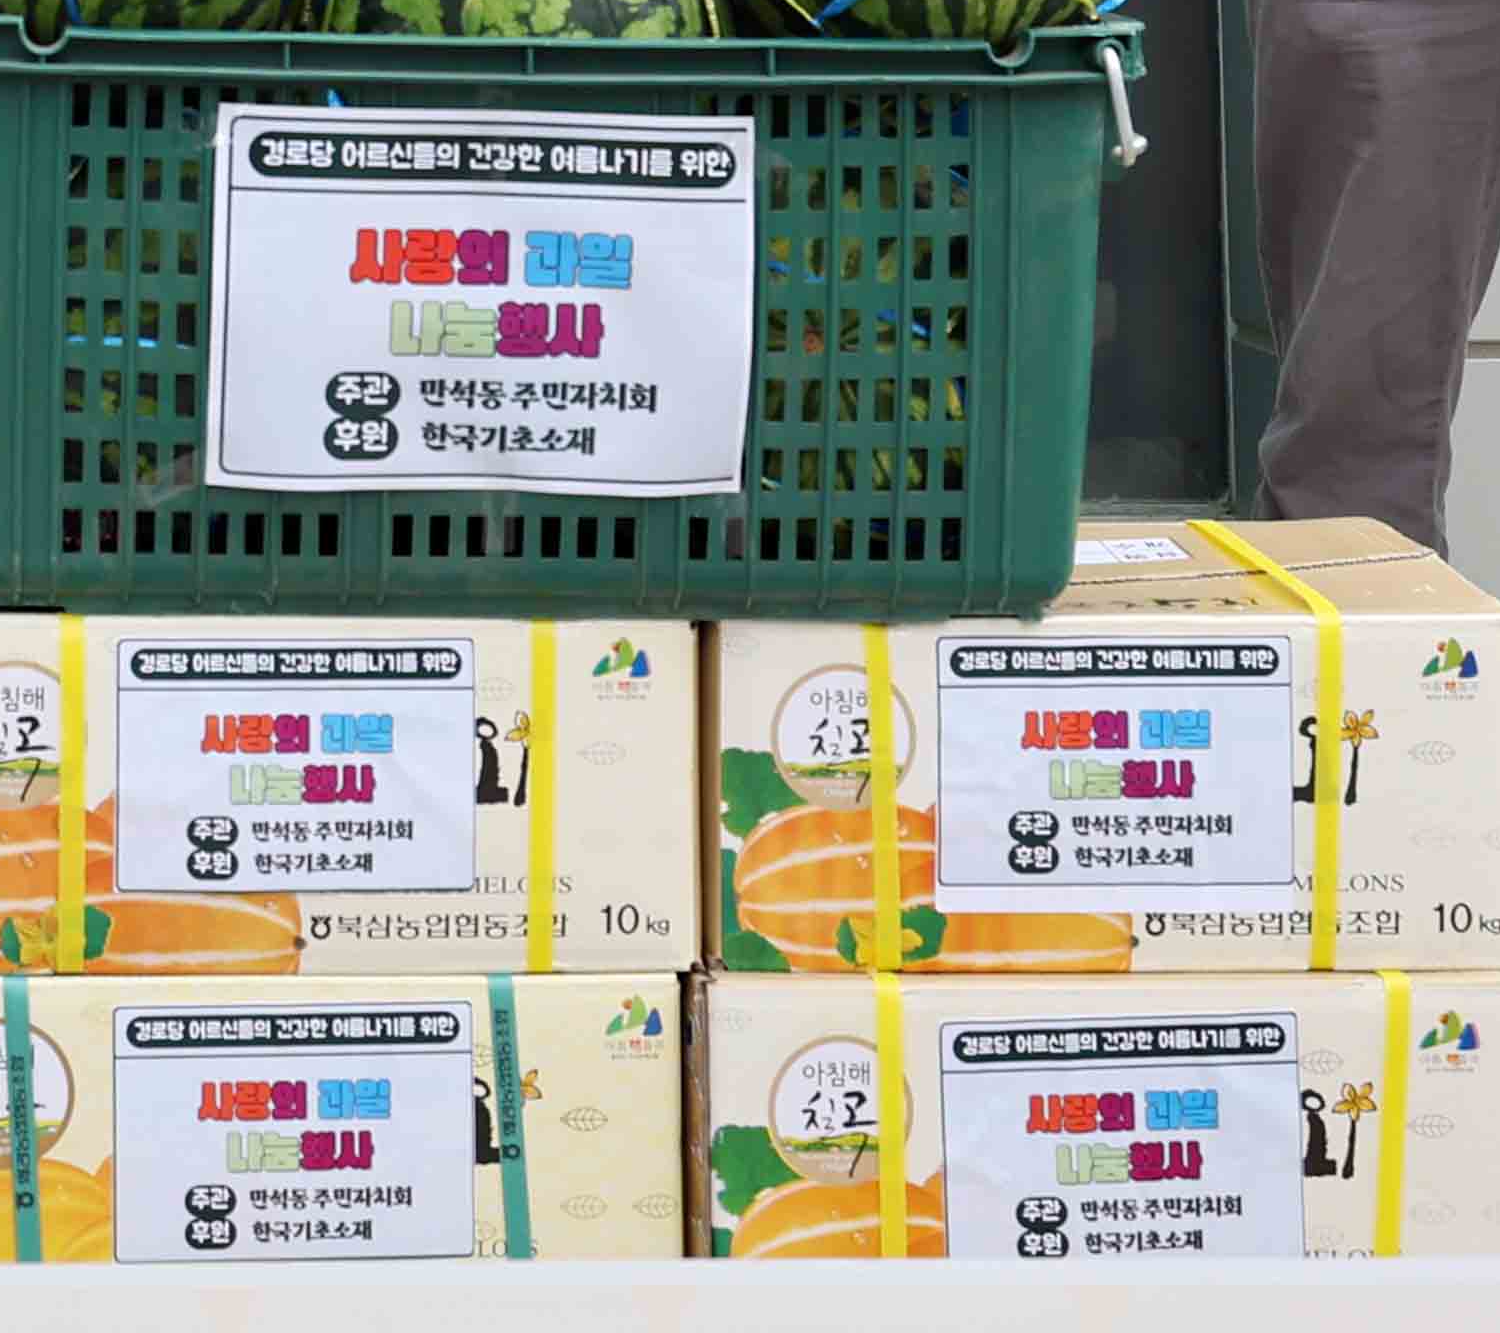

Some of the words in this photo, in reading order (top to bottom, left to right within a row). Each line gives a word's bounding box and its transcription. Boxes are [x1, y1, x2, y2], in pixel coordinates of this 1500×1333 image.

[260, 139, 335, 169] 경로당
[341, 142, 461, 172] 어르신들의
[468, 143, 544, 174] 건강한
[552, 147, 673, 176] 여름나기를
[680, 149, 731, 177] 위한
[350, 228, 509, 285] 사랑의
[524, 231, 633, 290] 과일
[390, 300, 603, 358] 나눔행사
[335, 376, 392, 407] 주관
[420, 379, 507, 410] 만석동
[512, 382, 658, 412] 주민자치회
[333, 419, 389, 452] 후원
[422, 423, 596, 455] 한국기초소재
[201, 714, 310, 754] 사랑의
[321, 714, 394, 754] 과일
[1021, 710, 1128, 749] 사랑의
[1139, 710, 1211, 749] 과일
[230, 764, 376, 805] 나눔행사
[1050, 759, 1194, 799] 나눔행사
[193, 820, 232, 840] 주관
[252, 821, 308, 842] 만석동
[315, 820, 413, 841] 주민자치회
[1014, 815, 1052, 834] 주관
[1072, 816, 1128, 836] 만석동
[1134, 815, 1232, 835] 주민자치회
[193, 853, 232, 875] 후원
[255, 853, 373, 873] 한국기초소재
[1014, 847, 1052, 868] 후원
[1075, 847, 1193, 867] 한국기초소재
[600, 904, 640, 935] 10
[646, 916, 671, 936] kg
[1433, 902, 1473, 933] 10
[802, 1060, 871, 1087] 아침해
[198, 1081, 307, 1121] 사랑의
[318, 1079, 391, 1119] 과일
[1026, 1093, 1135, 1134] 사랑의
[1145, 1090, 1219, 1130] 과일
[226, 1130, 374, 1173] 나눔행사
[1056, 1141, 1202, 1185] 나눔행사
[191, 1188, 230, 1210] 주관
[250, 1187, 309, 1209] 만석동
[314, 1186, 412, 1208] 주민자치회
[1022, 1200, 1061, 1222] 주관
[1081, 1199, 1138, 1221] 만석동
[1143, 1196, 1242, 1219] 주민자치회
[191, 1221, 230, 1244] 후원
[253, 1220, 372, 1242] 한국기초소재
[1022, 1232, 1061, 1255] 후원
[1086, 1230, 1203, 1253] 한국기초소재
